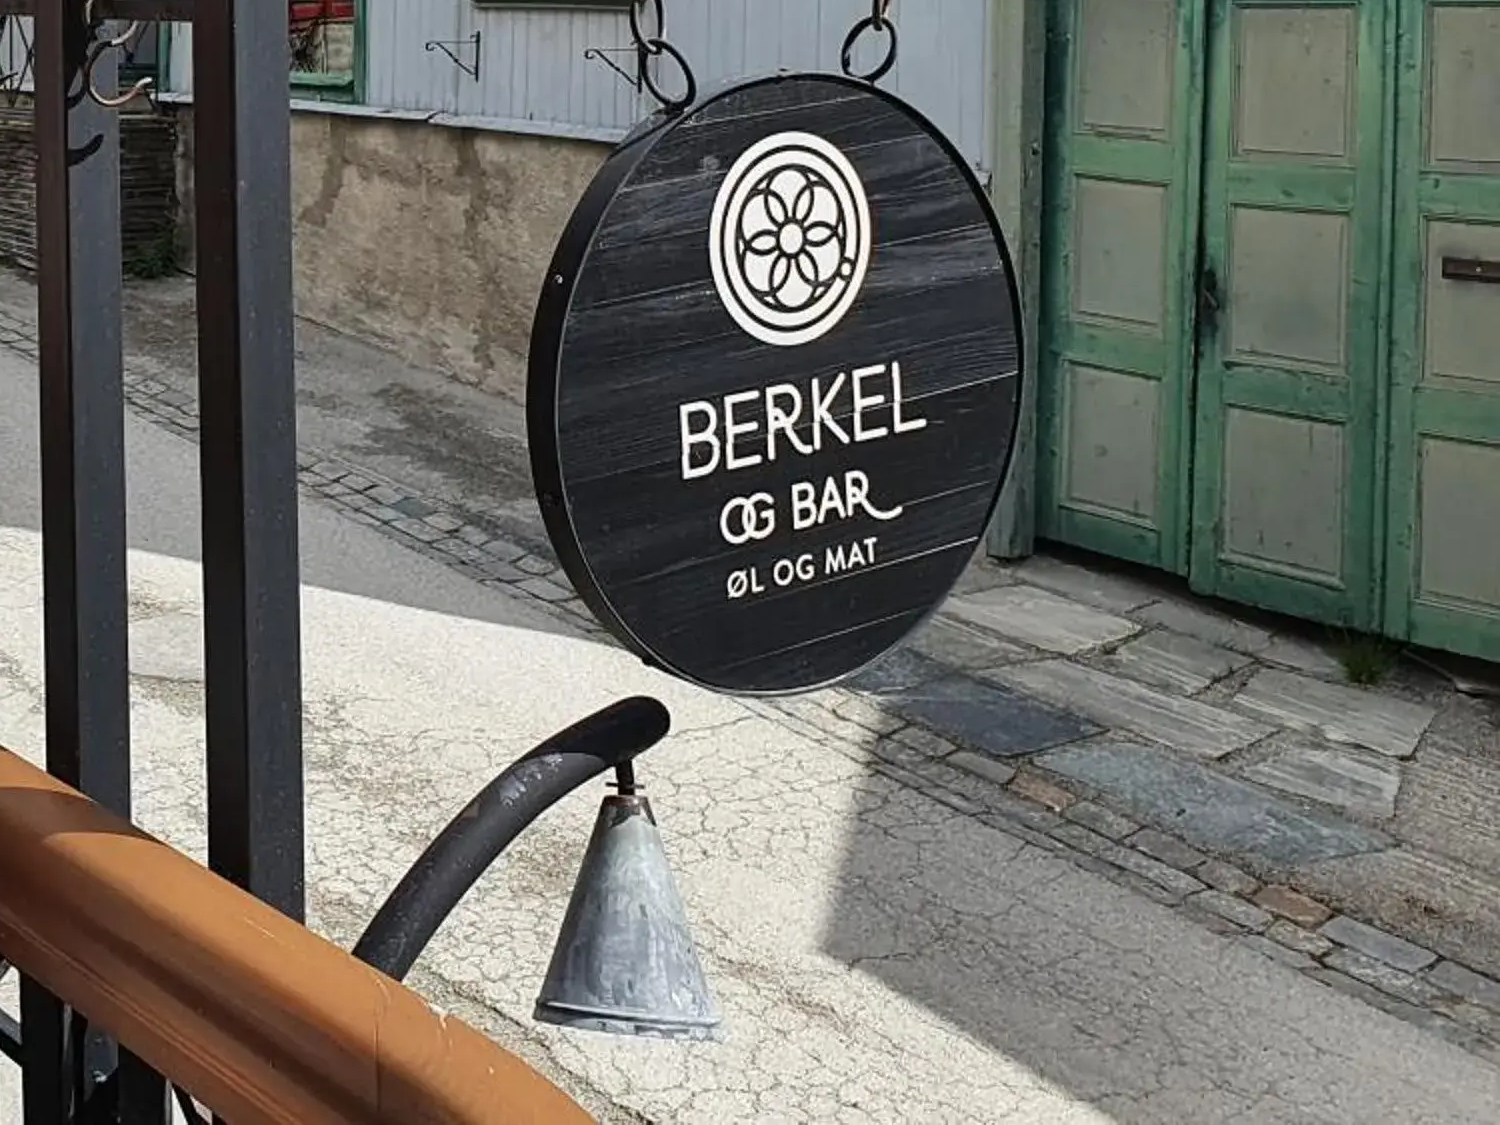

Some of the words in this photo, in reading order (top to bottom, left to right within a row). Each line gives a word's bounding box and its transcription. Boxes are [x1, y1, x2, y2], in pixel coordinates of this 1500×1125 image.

[679, 361, 927, 480] BERKEL
[720, 492, 775, 544] OG
[791, 470, 903, 530] BAR
[726, 567, 764, 599] ØL
[773, 554, 815, 586] OG
[824, 537, 877, 574] MAT
